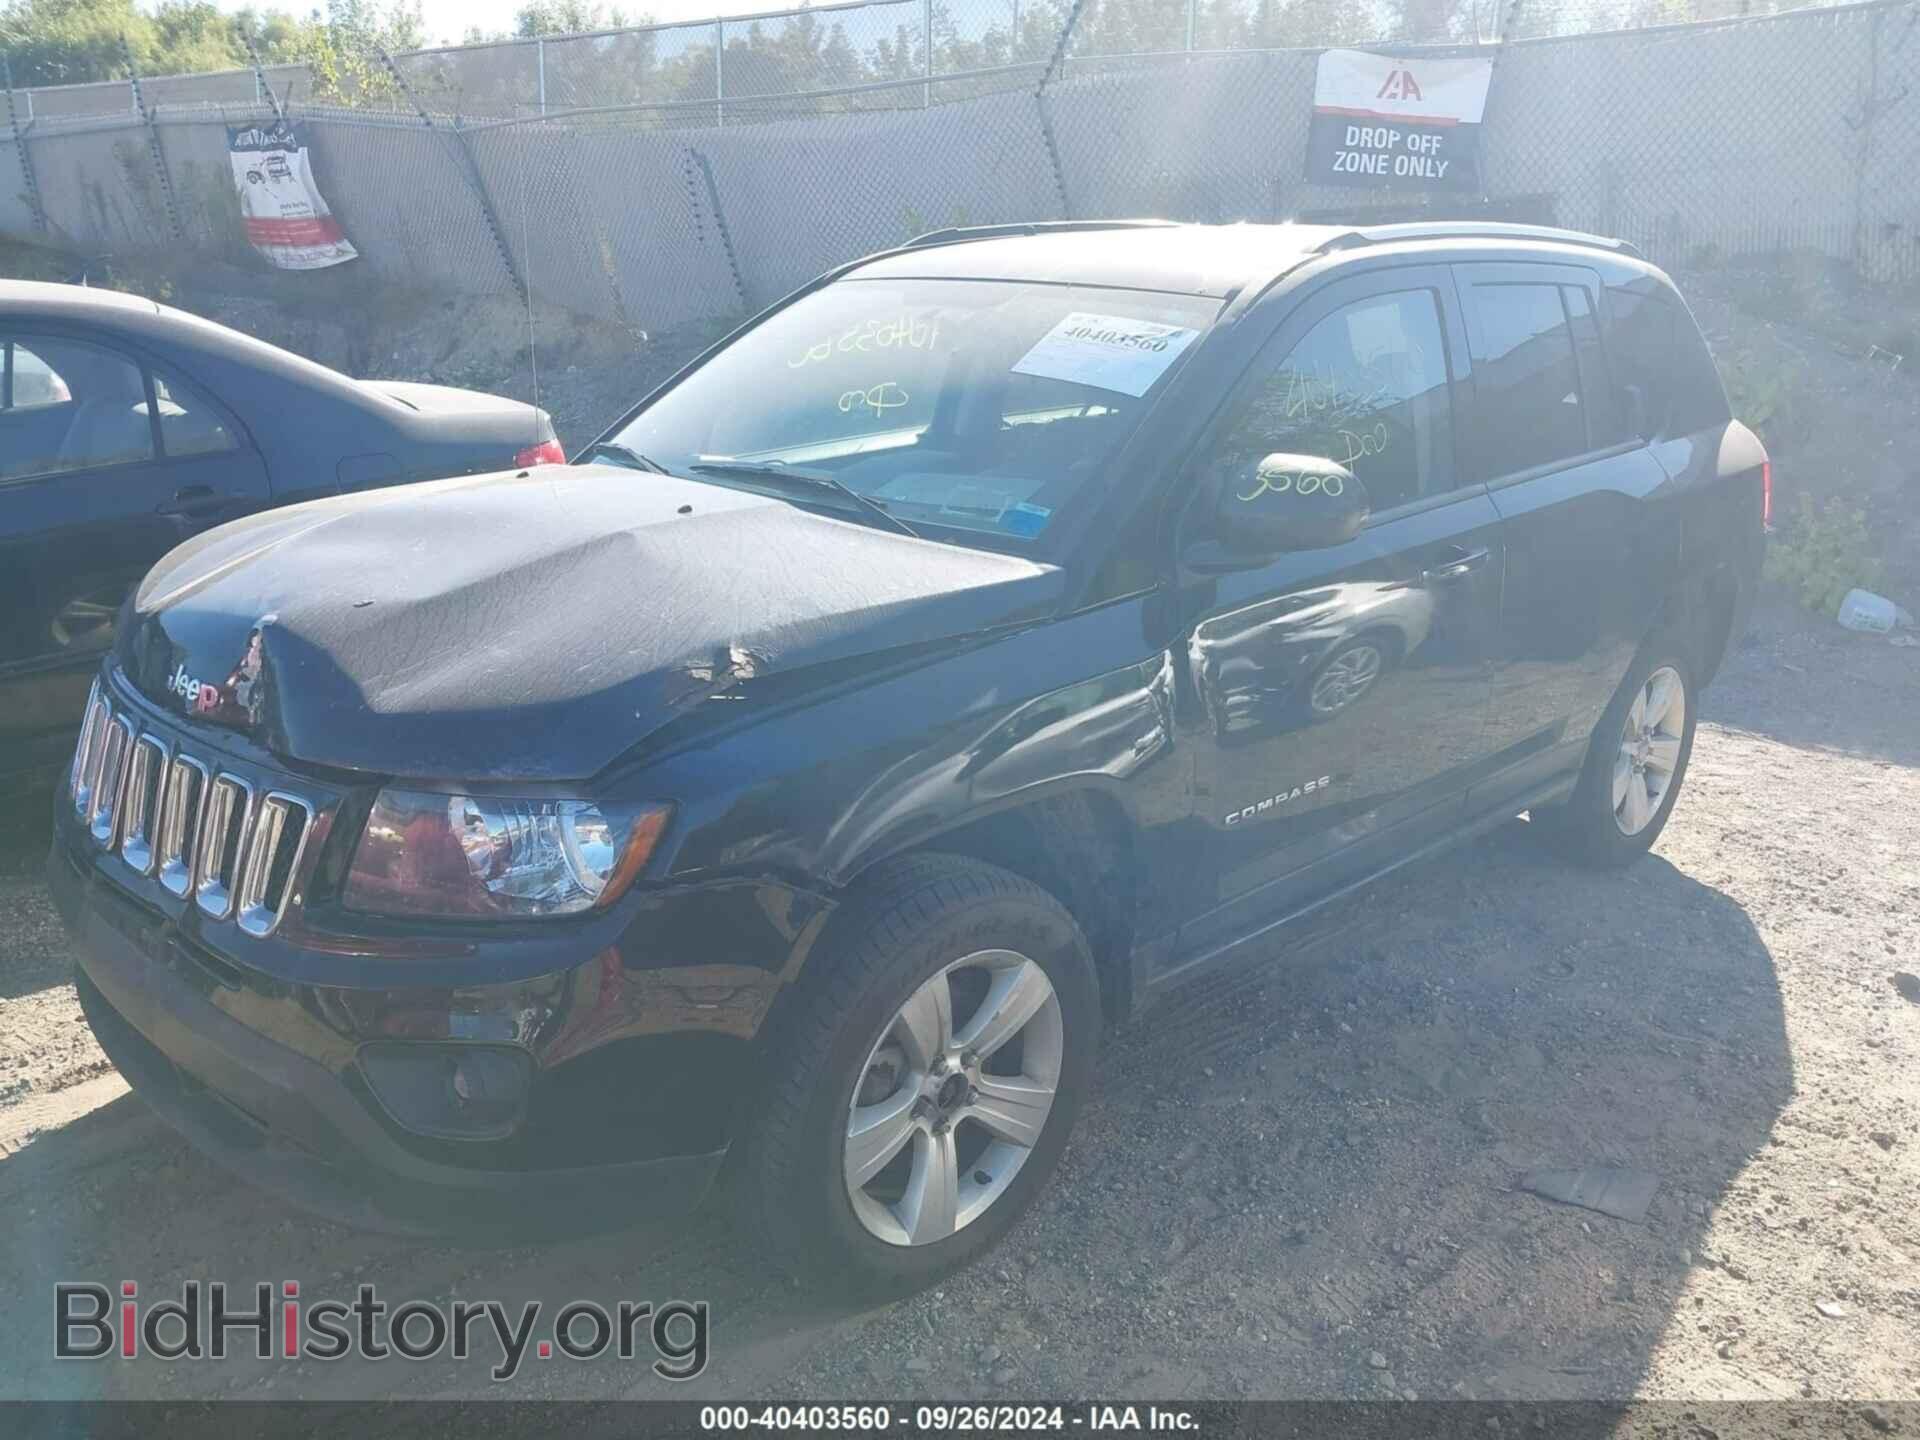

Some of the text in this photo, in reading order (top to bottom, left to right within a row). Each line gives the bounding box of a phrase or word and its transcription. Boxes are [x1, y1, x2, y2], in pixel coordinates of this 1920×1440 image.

[1344, 125, 1443, 156] DROP OFF
[1332, 151, 1449, 178] ZONE ONLY
[167, 663, 219, 713] Jeep
[1224, 775, 1331, 826] COMPASS
